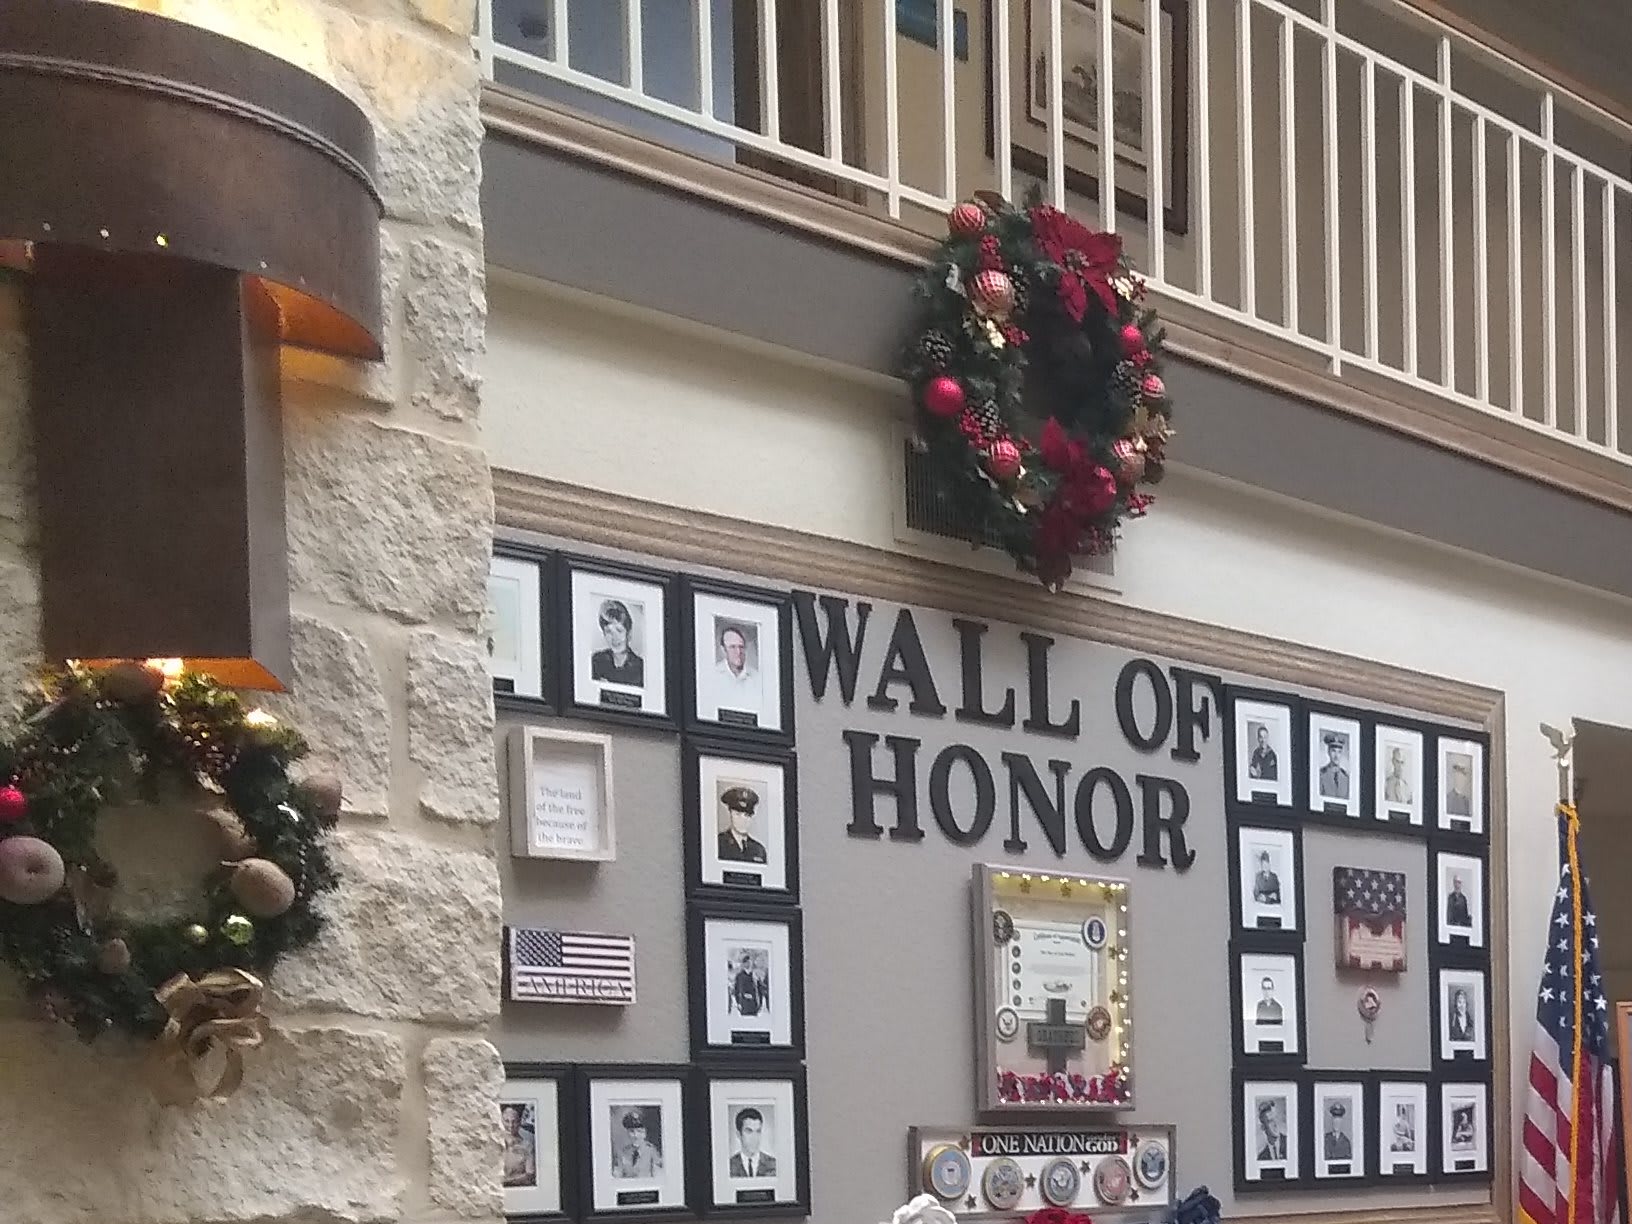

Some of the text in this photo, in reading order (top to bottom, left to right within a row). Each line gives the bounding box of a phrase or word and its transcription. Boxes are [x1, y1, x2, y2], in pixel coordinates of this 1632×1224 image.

[791, 589, 1223, 762] WALL OF
[842, 729, 1196, 873] HONOR
[982, 1134, 1085, 1154] ONE NATION
[1085, 1140, 1119, 1153] GOD
